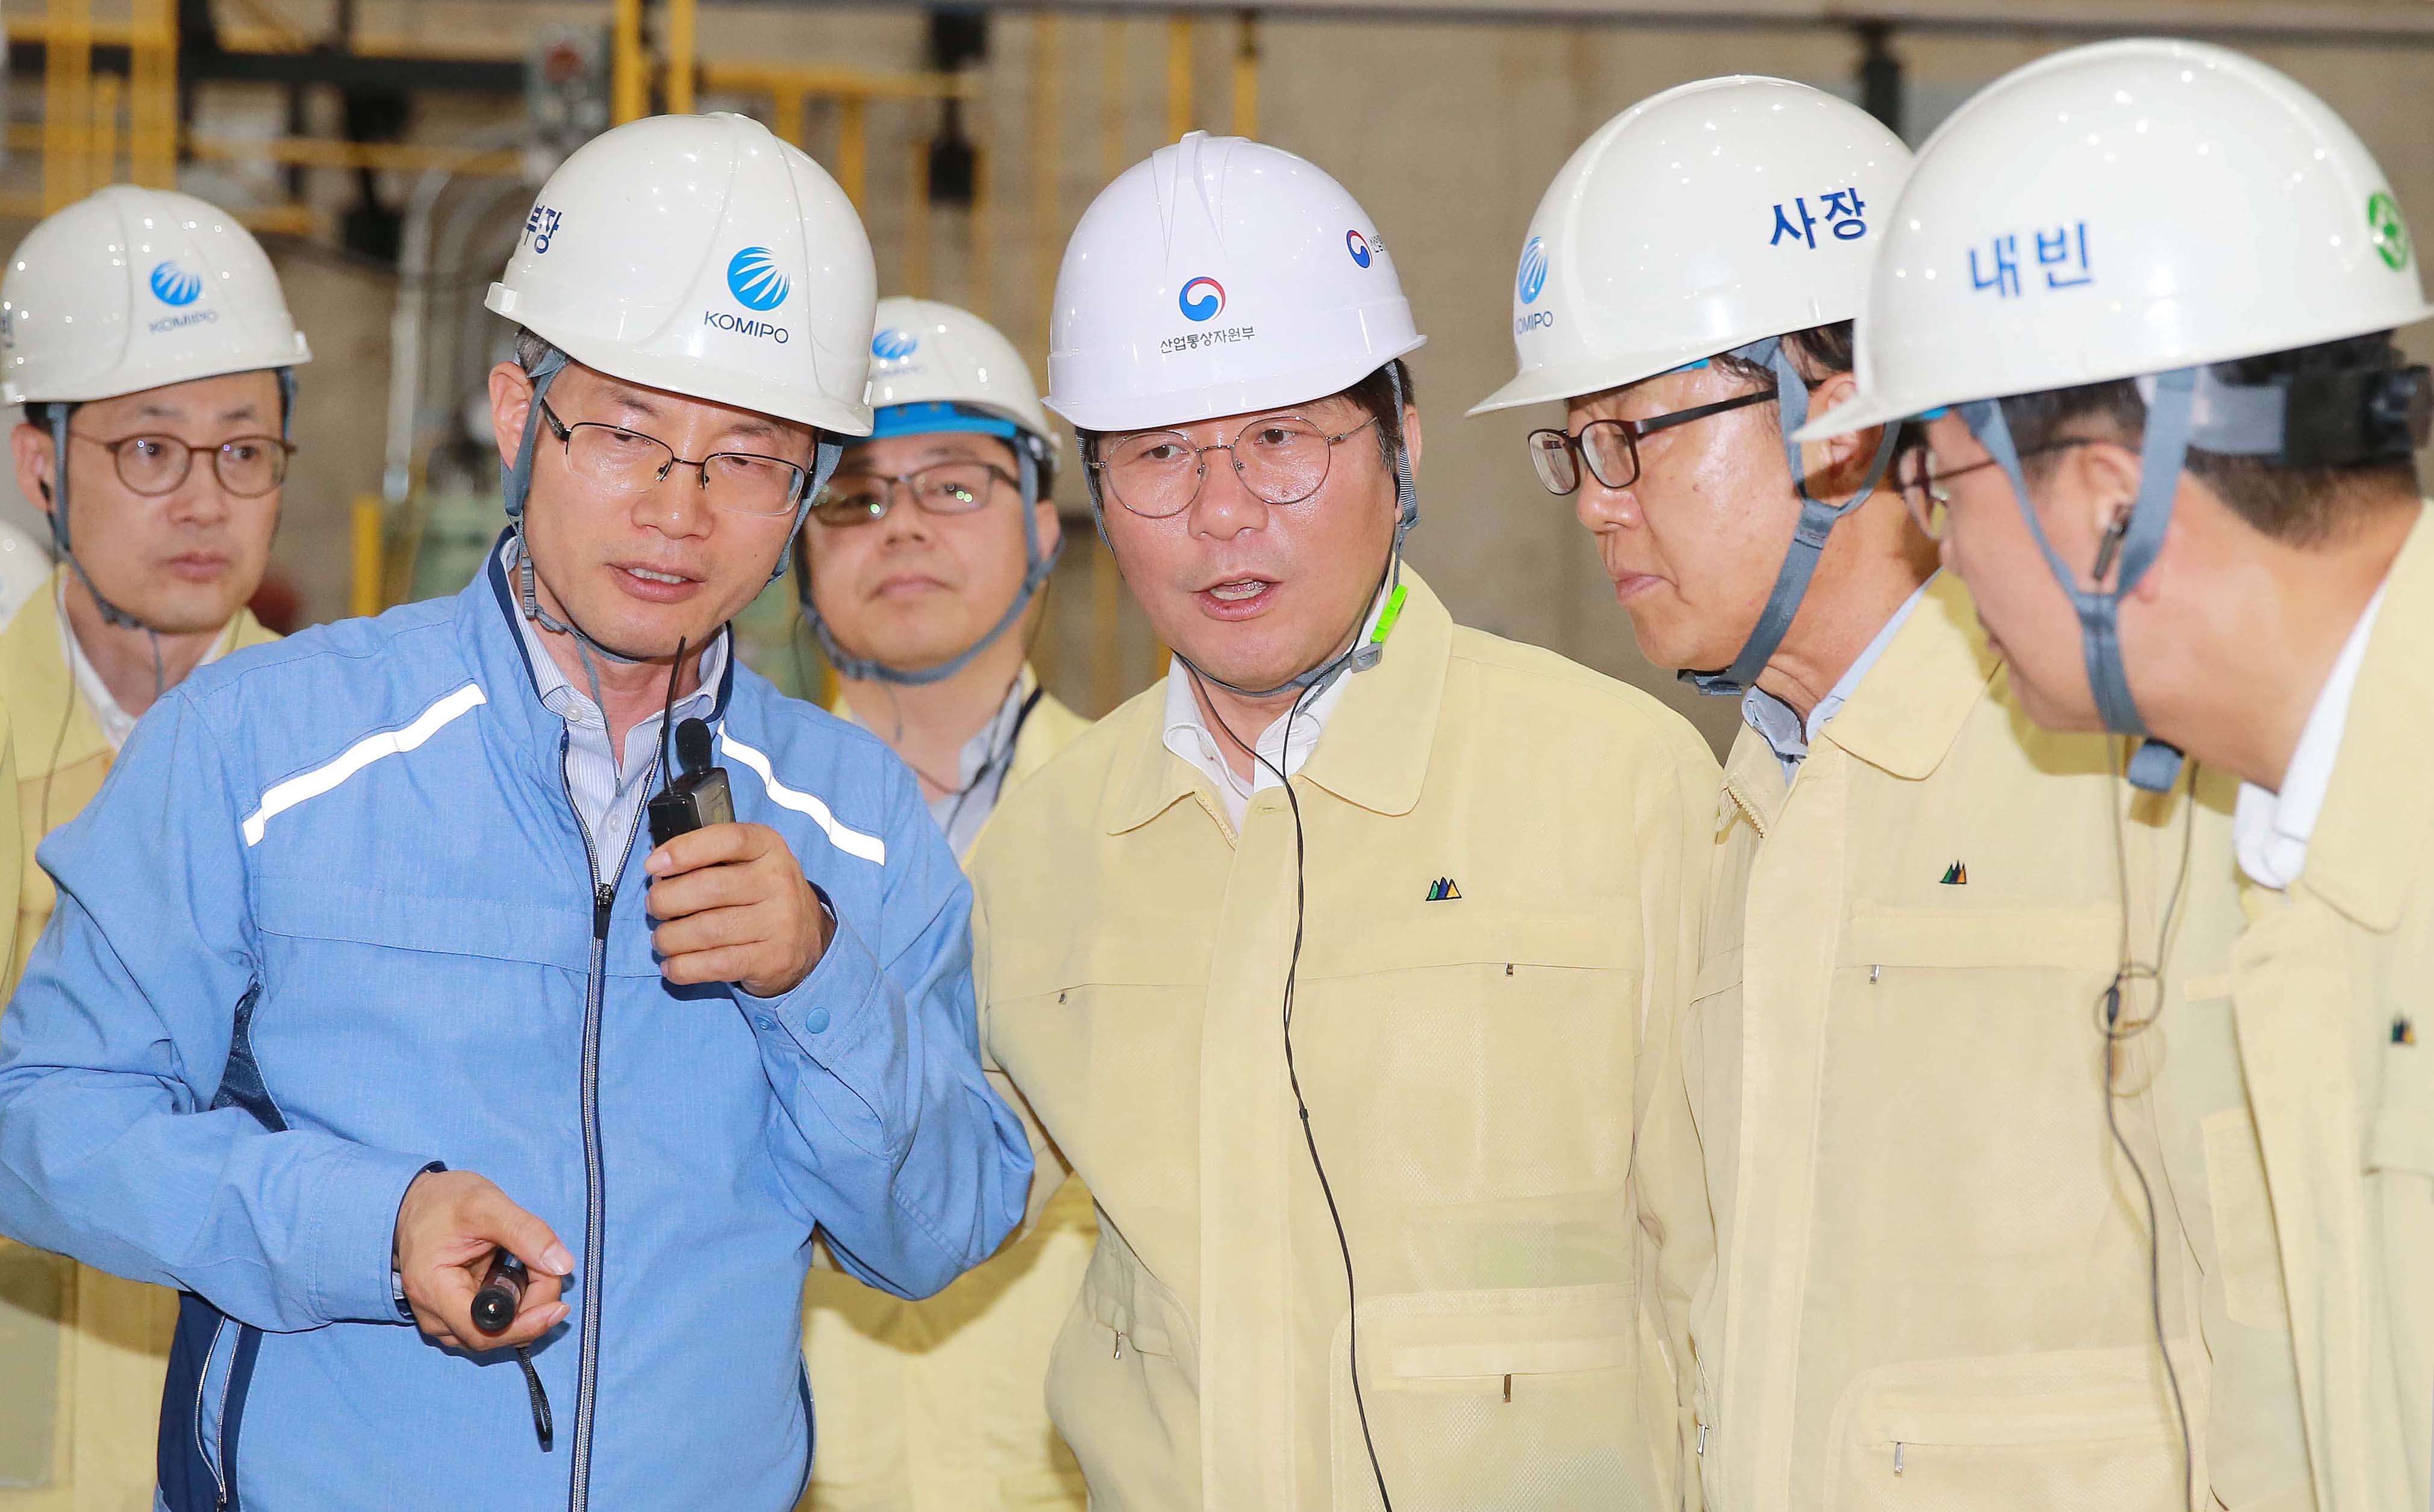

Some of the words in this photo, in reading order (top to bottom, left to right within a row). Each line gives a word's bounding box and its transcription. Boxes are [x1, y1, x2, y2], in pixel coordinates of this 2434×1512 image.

[1770, 187, 1867, 249] 사장
[1970, 222, 2092, 297] 내빈
[704, 311, 789, 344] KOMIPO
[1515, 311, 1553, 334] OMIPO
[1160, 326, 1255, 354] 산업통상자원부
